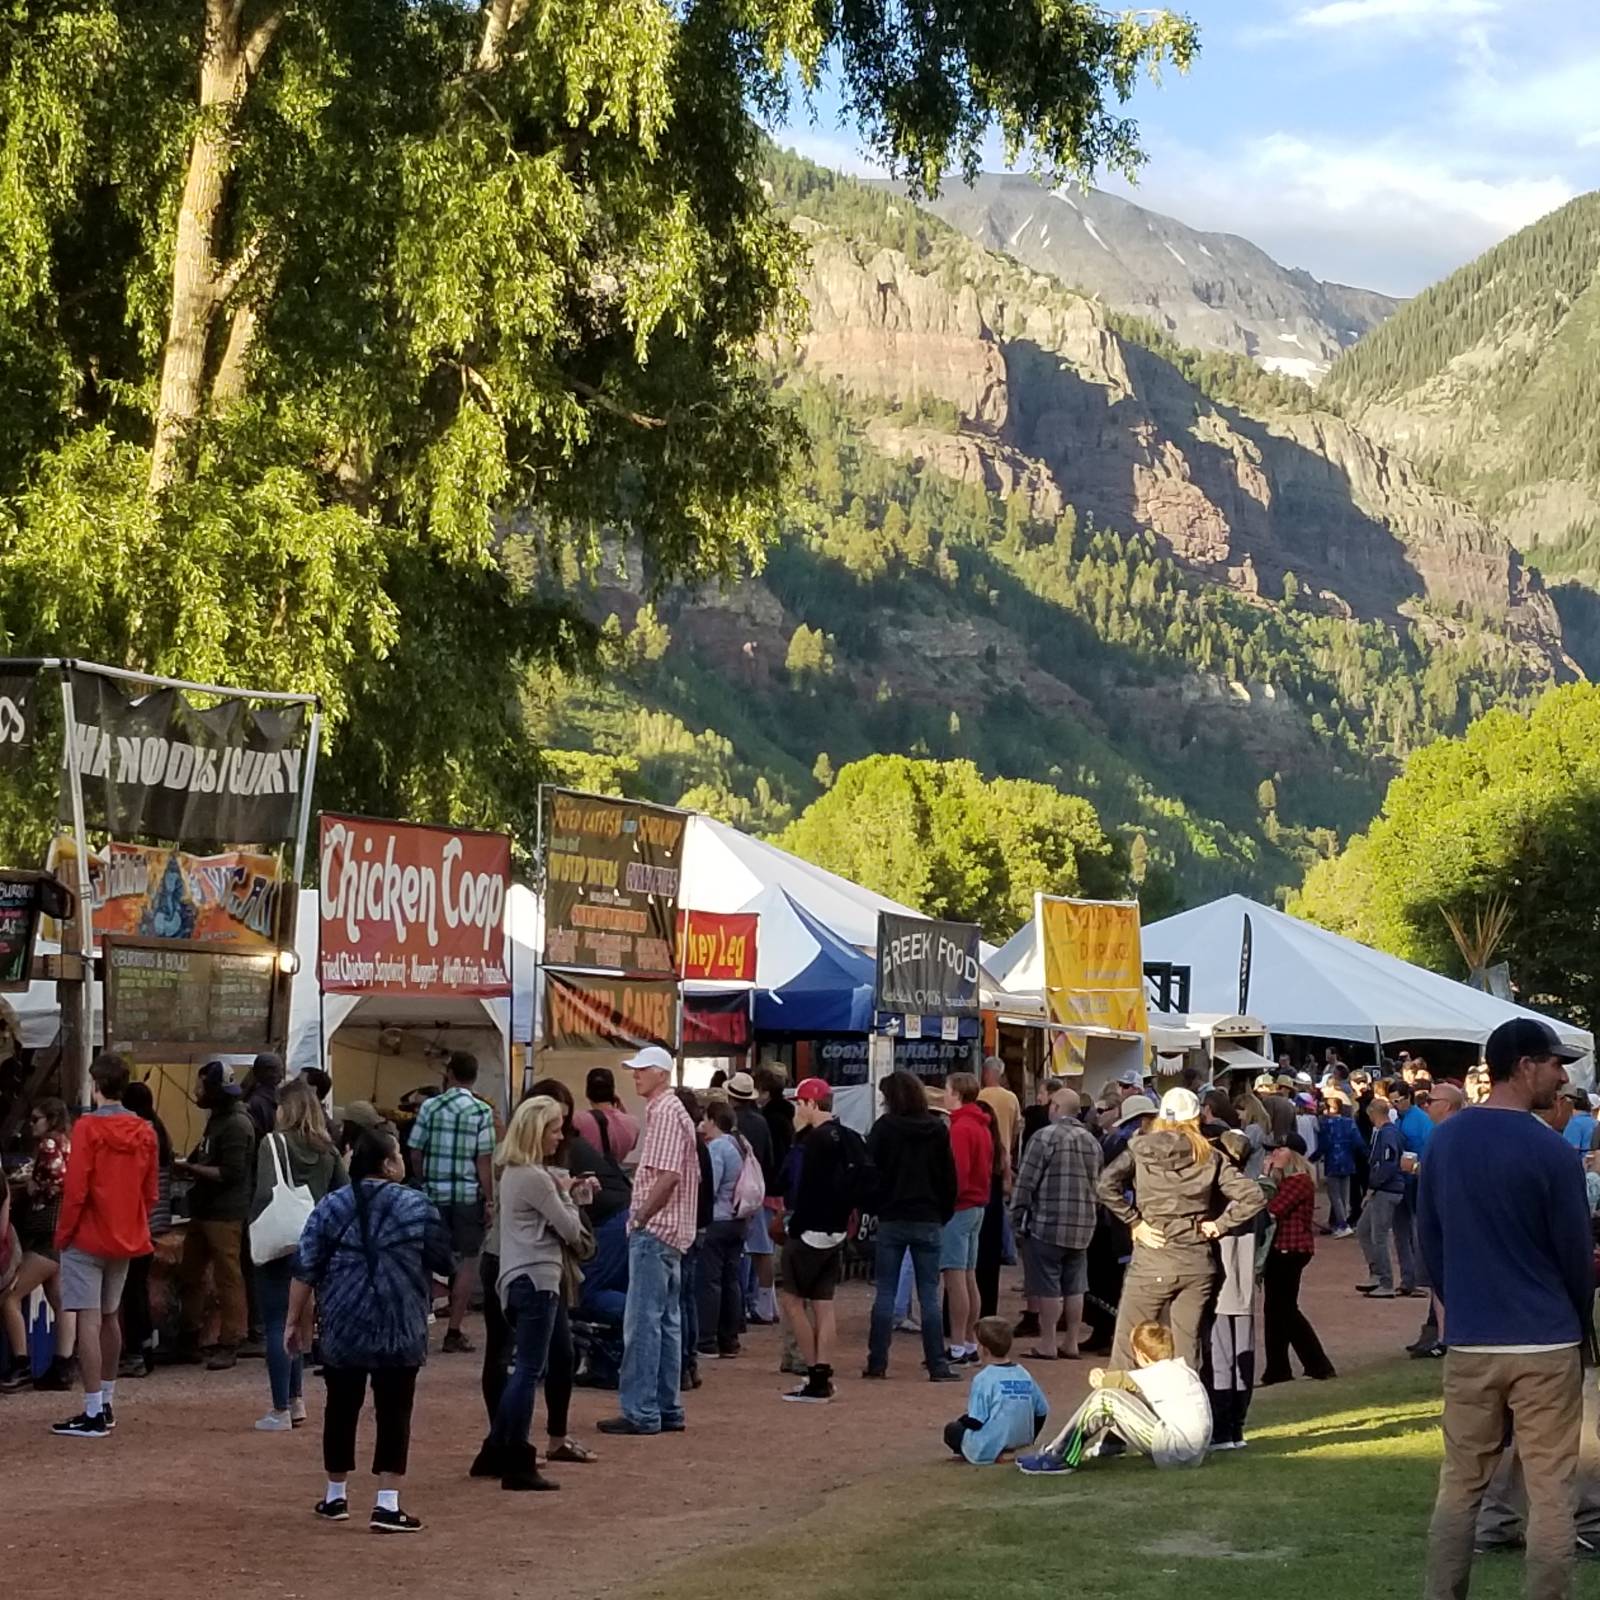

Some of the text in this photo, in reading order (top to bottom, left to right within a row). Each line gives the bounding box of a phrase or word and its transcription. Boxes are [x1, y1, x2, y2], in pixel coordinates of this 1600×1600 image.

[321, 823, 504, 951] Chicken Coop
[718, 924, 746, 977] Leg
[883, 932, 979, 983] GREEK FOOD
[622, 987, 672, 1042] CAKES
